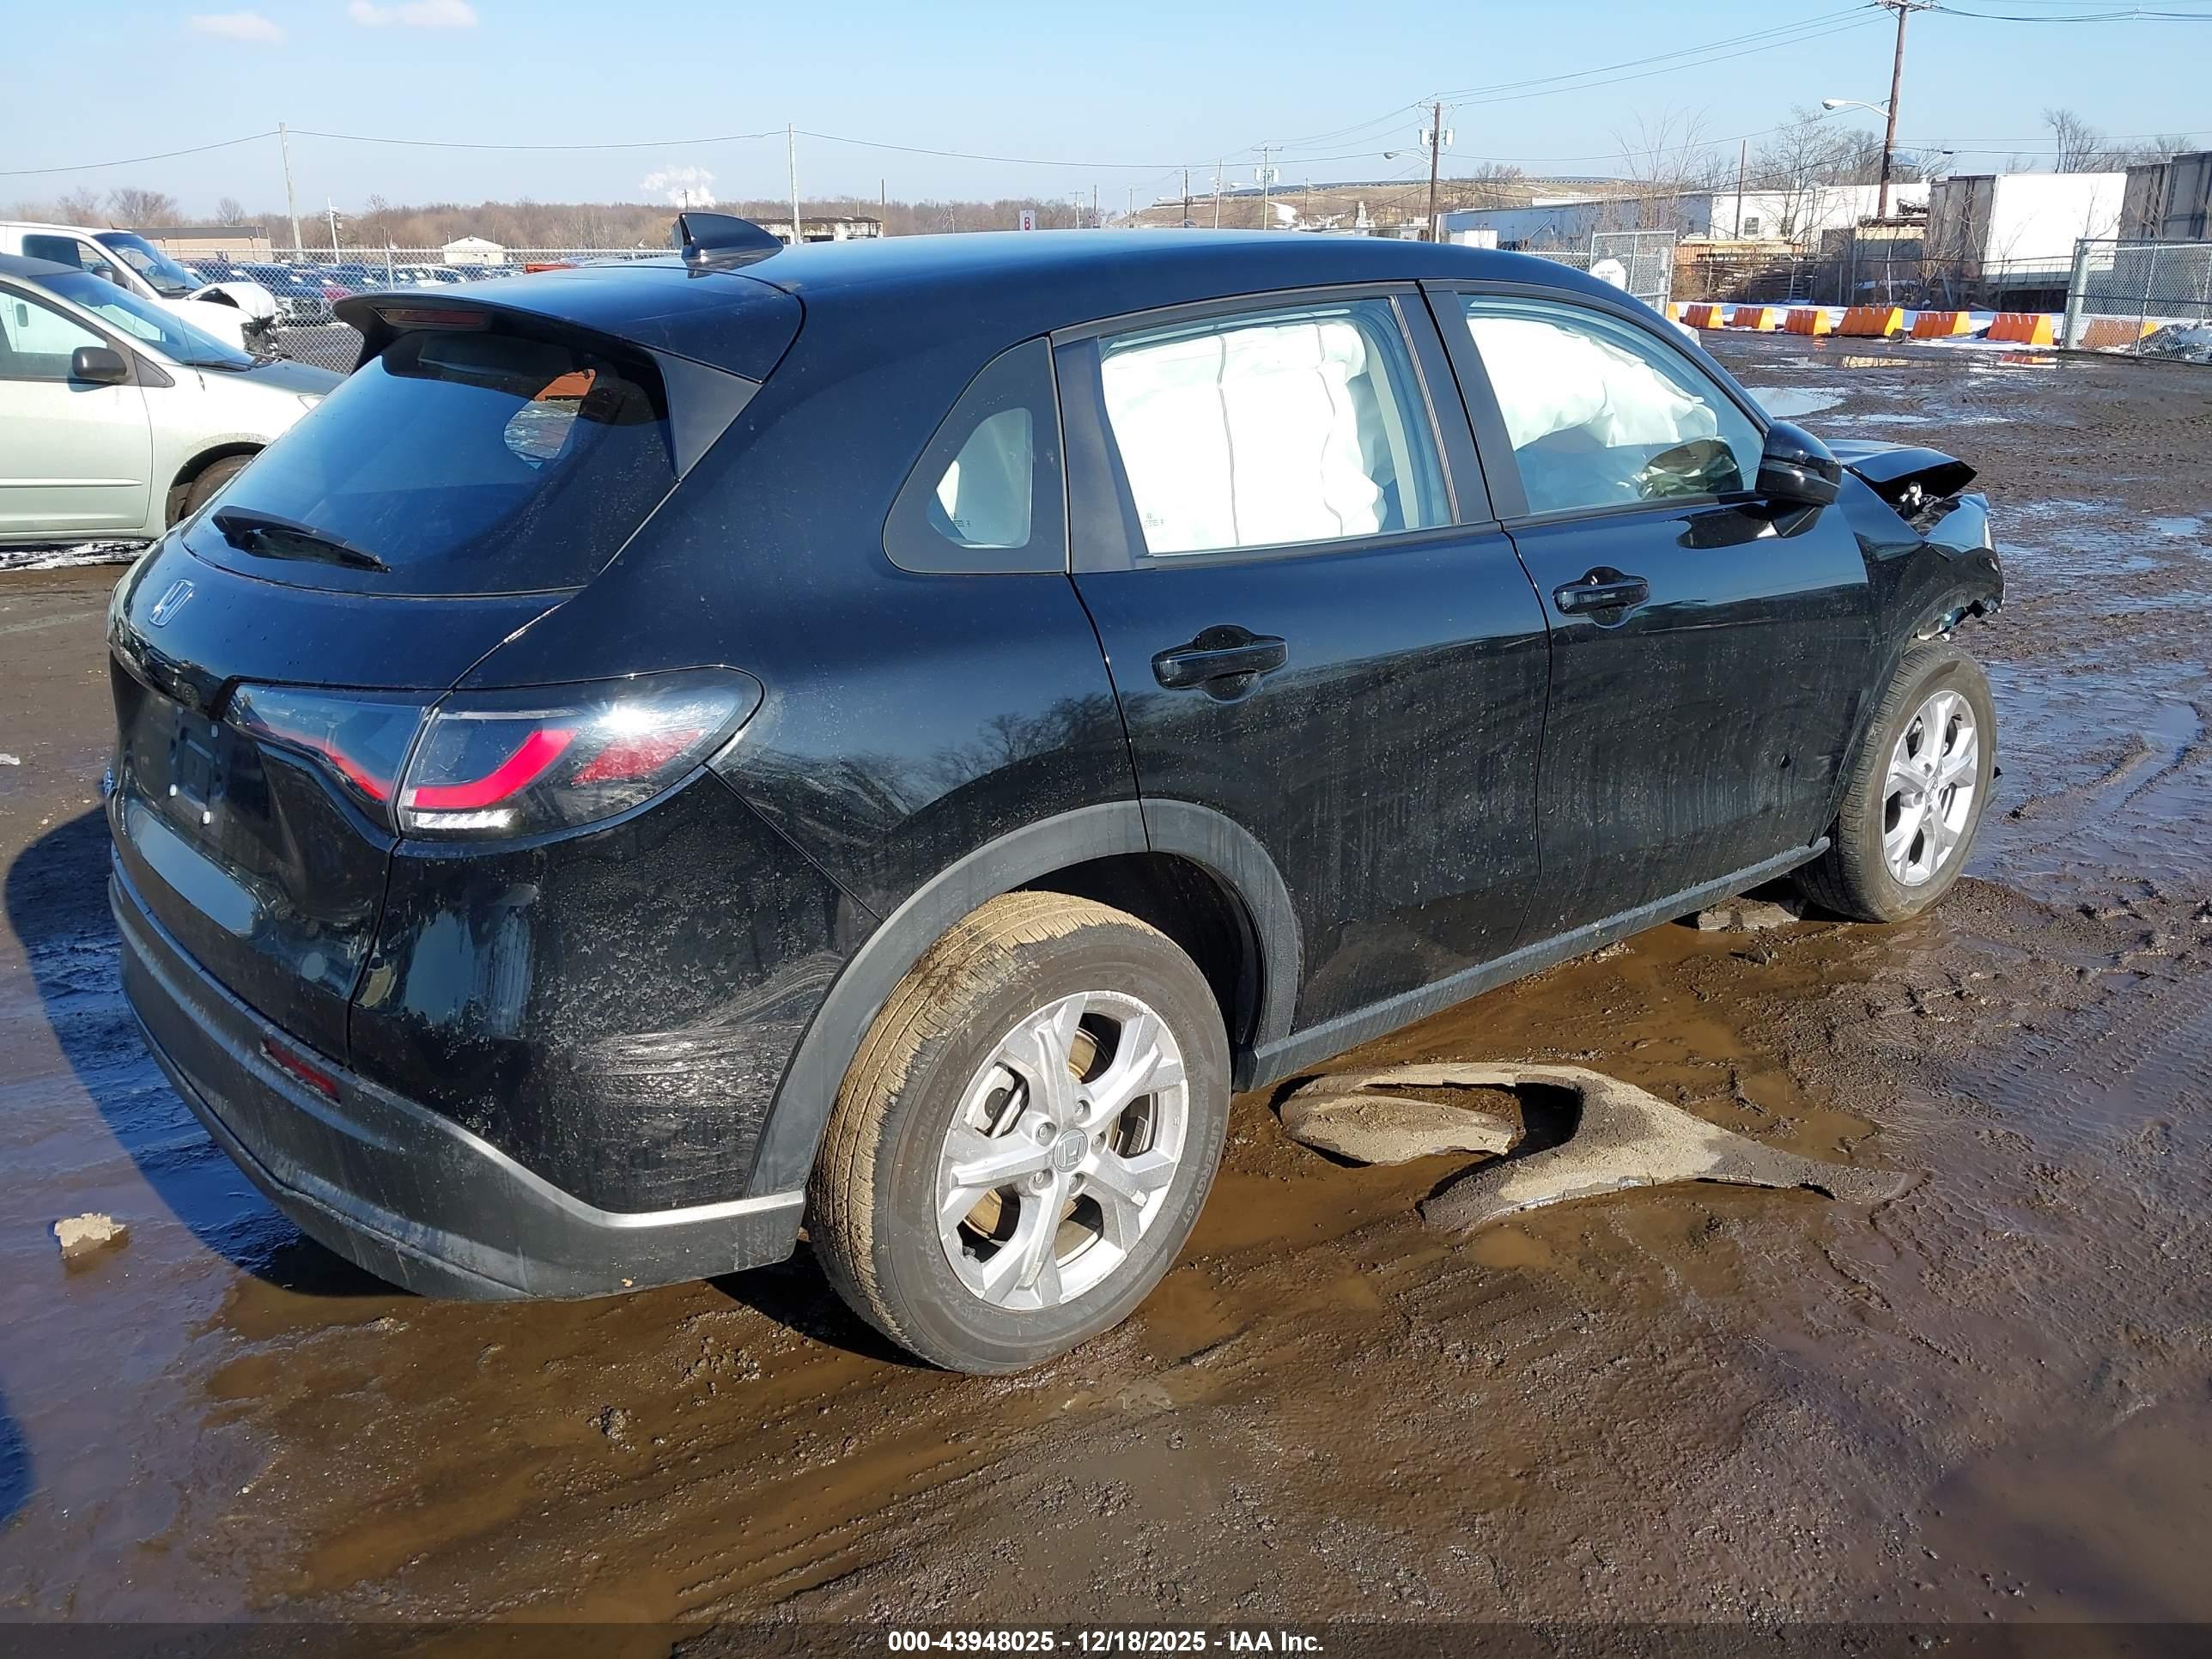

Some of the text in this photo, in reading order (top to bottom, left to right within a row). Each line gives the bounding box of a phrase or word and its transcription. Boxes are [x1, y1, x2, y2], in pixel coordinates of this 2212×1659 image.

[1024, 216, 1031, 230] B
[1182, 1115, 1223, 1228] KINERGY GT
